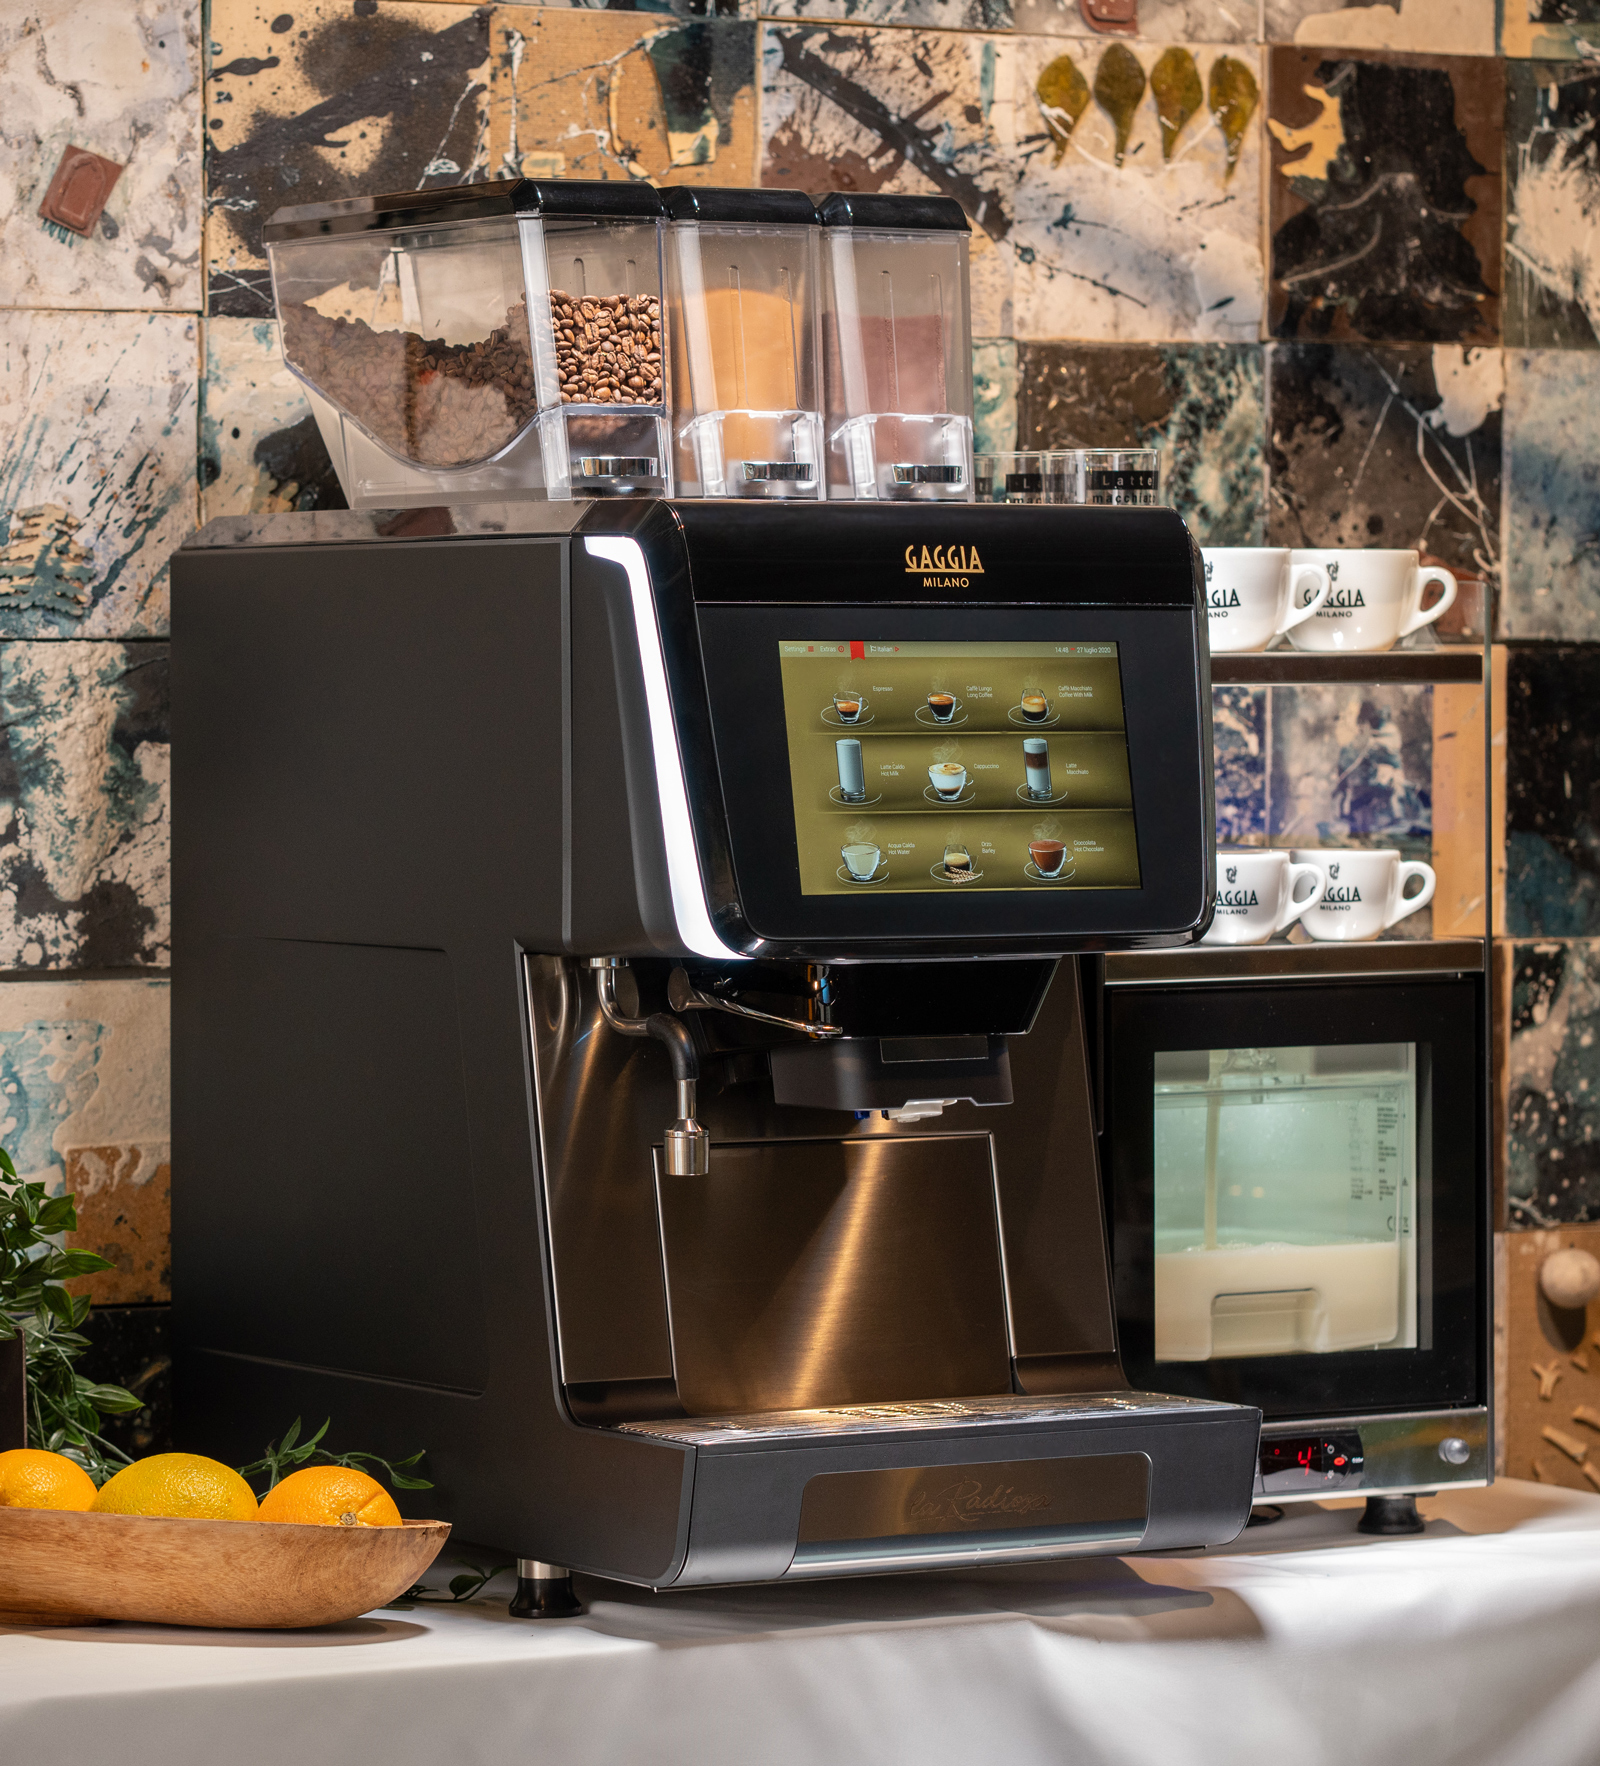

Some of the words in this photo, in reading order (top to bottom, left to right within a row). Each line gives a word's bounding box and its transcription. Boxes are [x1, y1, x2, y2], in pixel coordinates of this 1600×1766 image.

[1102, 474, 1153, 486] Latte
[905, 545, 984, 573] GAGGIA
[923, 577, 969, 588] MILANO
[1207, 589, 1241, 608] GIA
[1303, 589, 1366, 608] GGIA
[784, 645, 806, 654] Settings
[820, 645, 836, 653] Extras
[979, 685, 992, 693] Lungo
[1216, 890, 1258, 906] AGGIA
[1310, 886, 1361, 902] GGIA
[1298, 1446, 1312, 1476] 4
